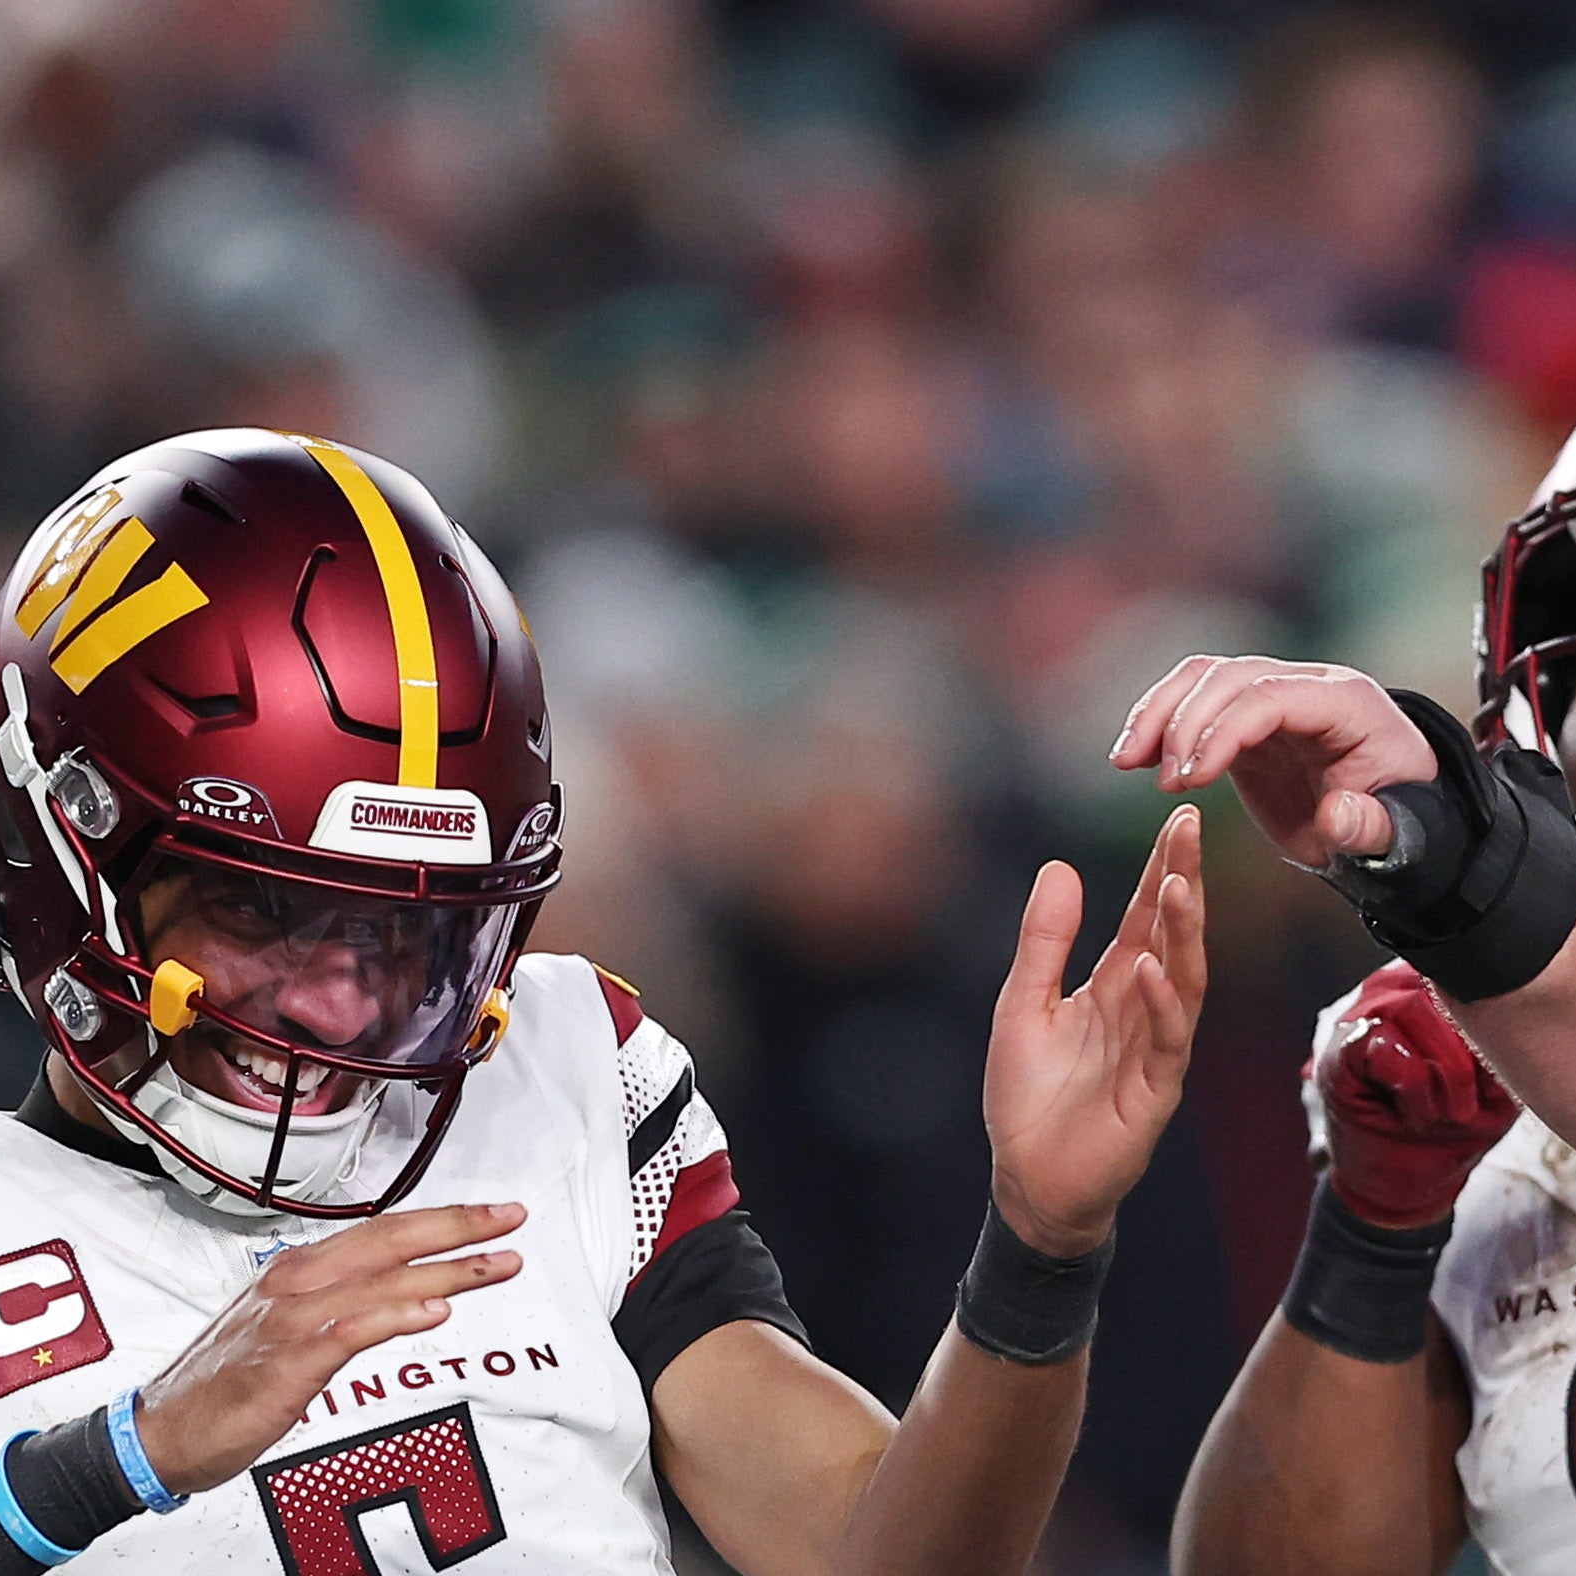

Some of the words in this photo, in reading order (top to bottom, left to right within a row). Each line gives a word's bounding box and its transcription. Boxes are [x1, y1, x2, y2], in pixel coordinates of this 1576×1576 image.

[178, 798, 266, 825] OAKLEY
[350, 802, 477, 834] COMMANDERS
[297, 1342, 560, 1425] INGTON
